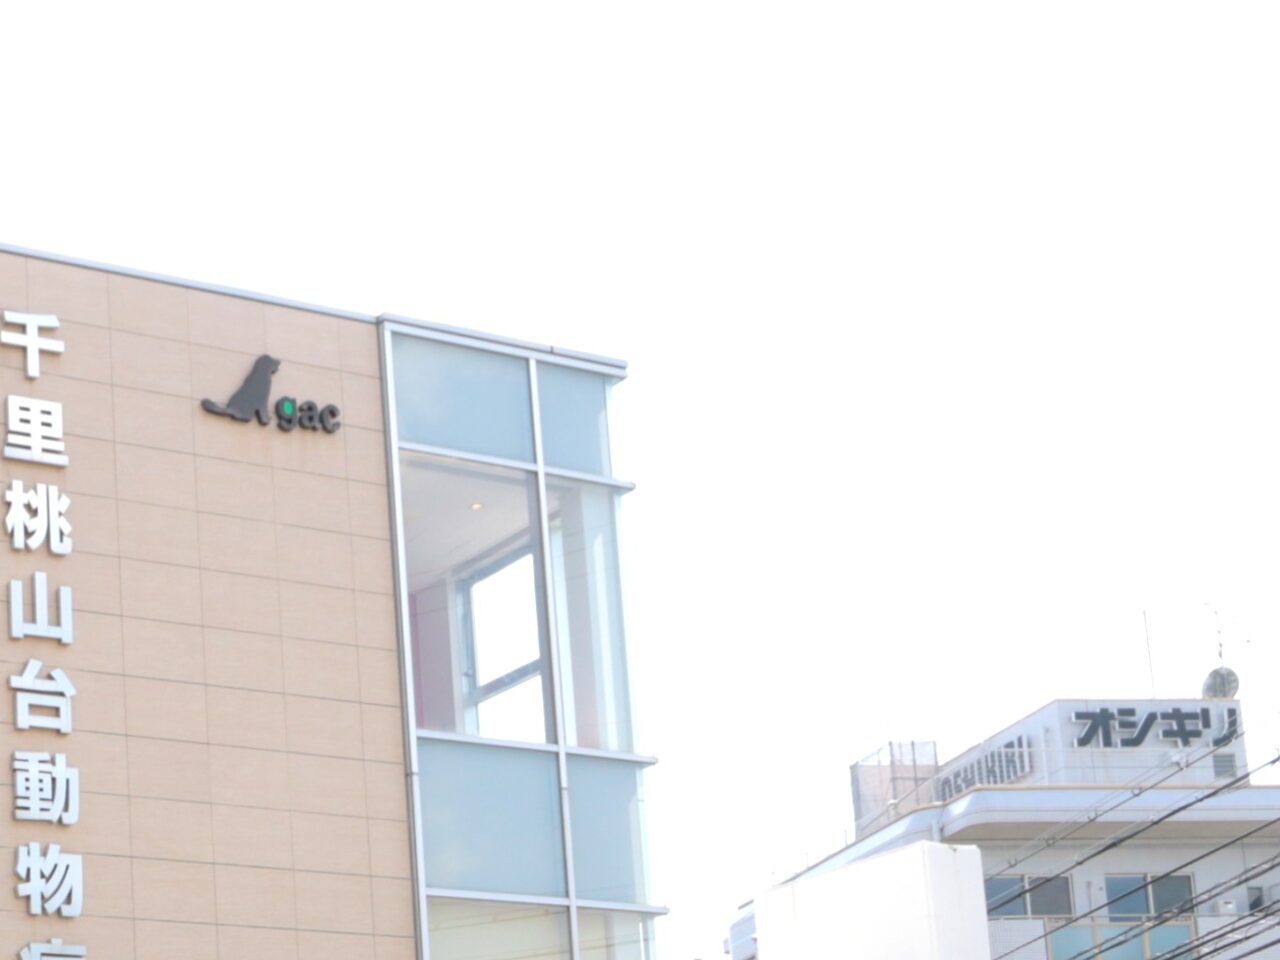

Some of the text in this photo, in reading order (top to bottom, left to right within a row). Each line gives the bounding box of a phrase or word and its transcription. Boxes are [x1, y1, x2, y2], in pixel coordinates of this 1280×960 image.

[275, 394, 341, 433] gac
[1073, 706, 1238, 749] オシキリ
